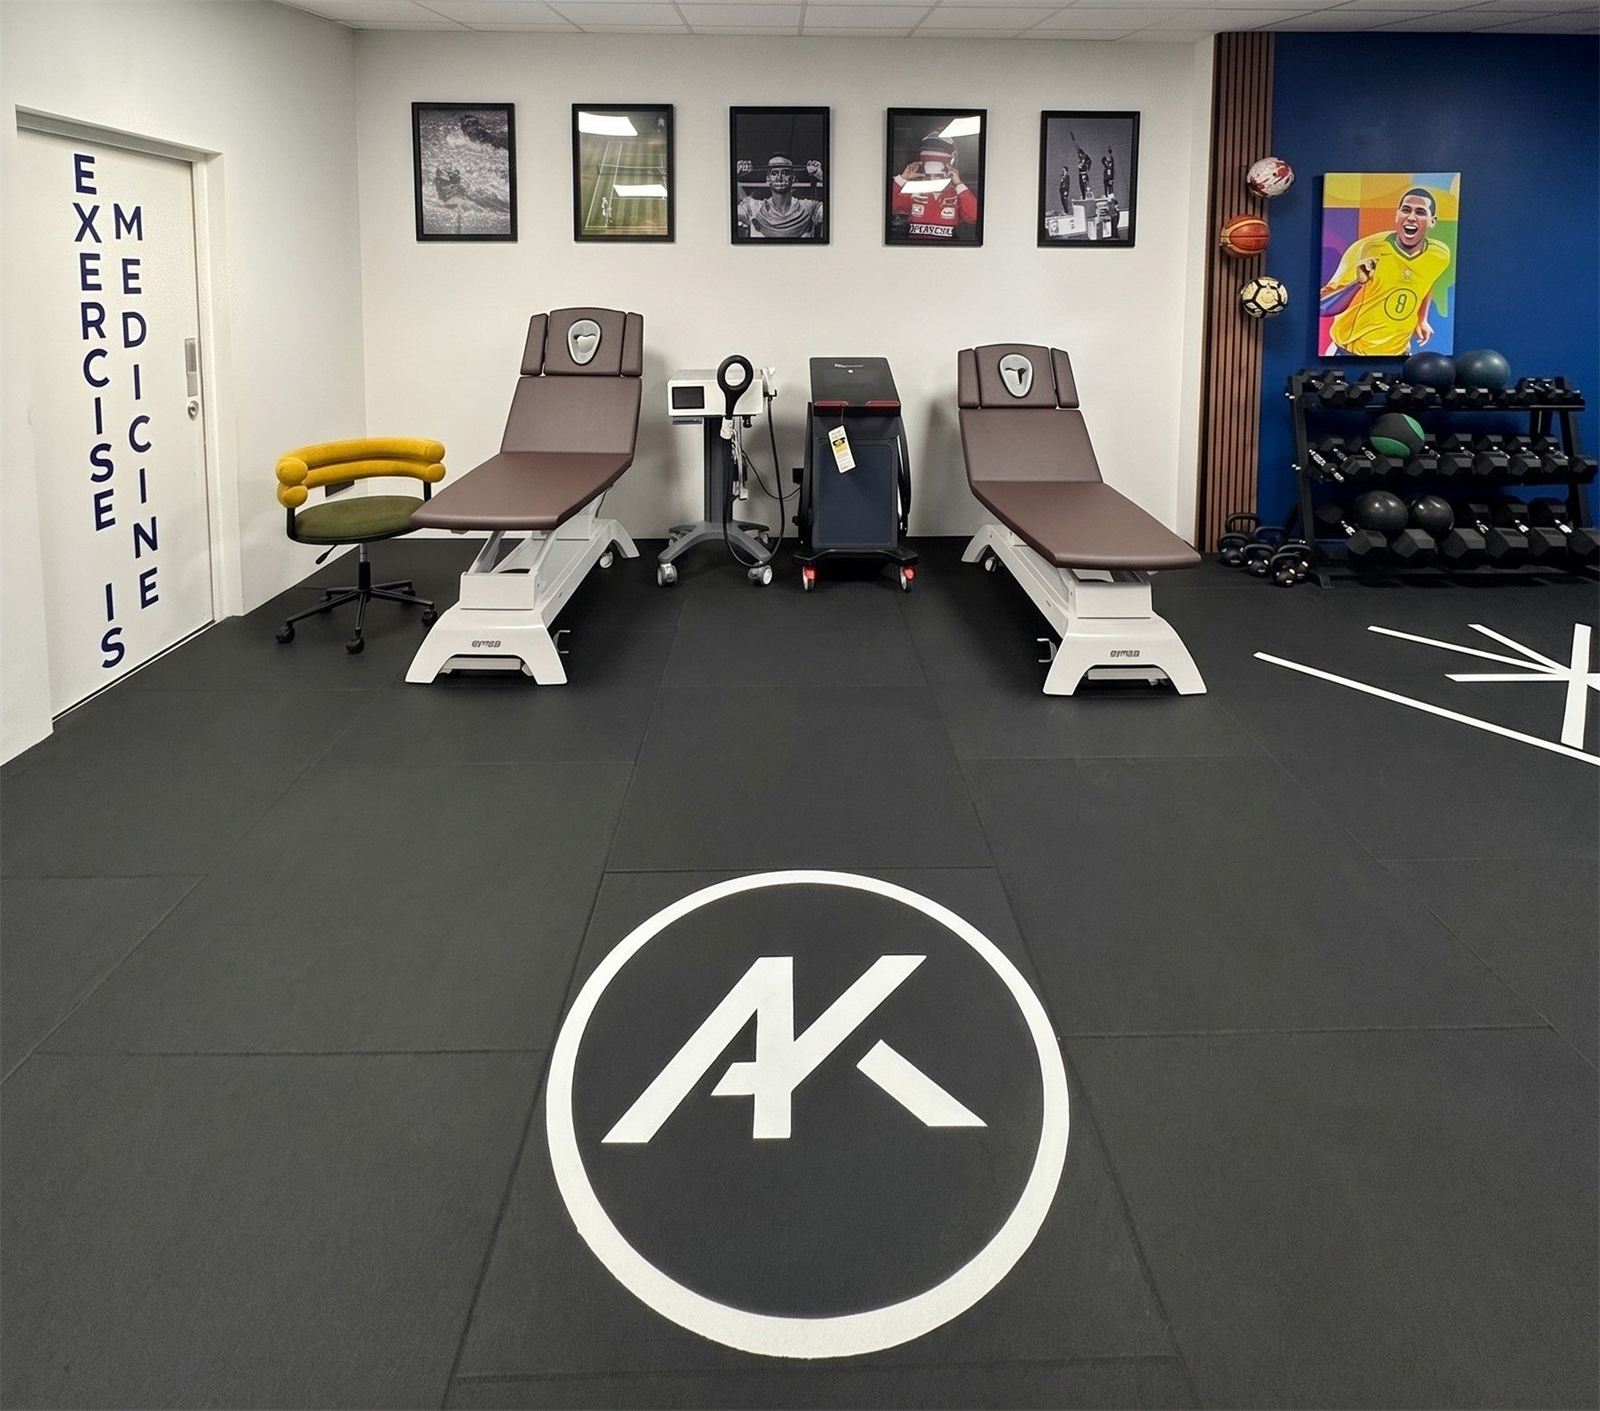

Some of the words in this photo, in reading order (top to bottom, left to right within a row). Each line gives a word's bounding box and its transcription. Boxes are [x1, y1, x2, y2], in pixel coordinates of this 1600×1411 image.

[73, 153, 116, 532] EXERCISE
[100, 582, 125, 669] IS
[113, 203, 159, 610] MEDICINE
[1395, 293, 1407, 314] 8
[600, 954, 988, 1144] AK
